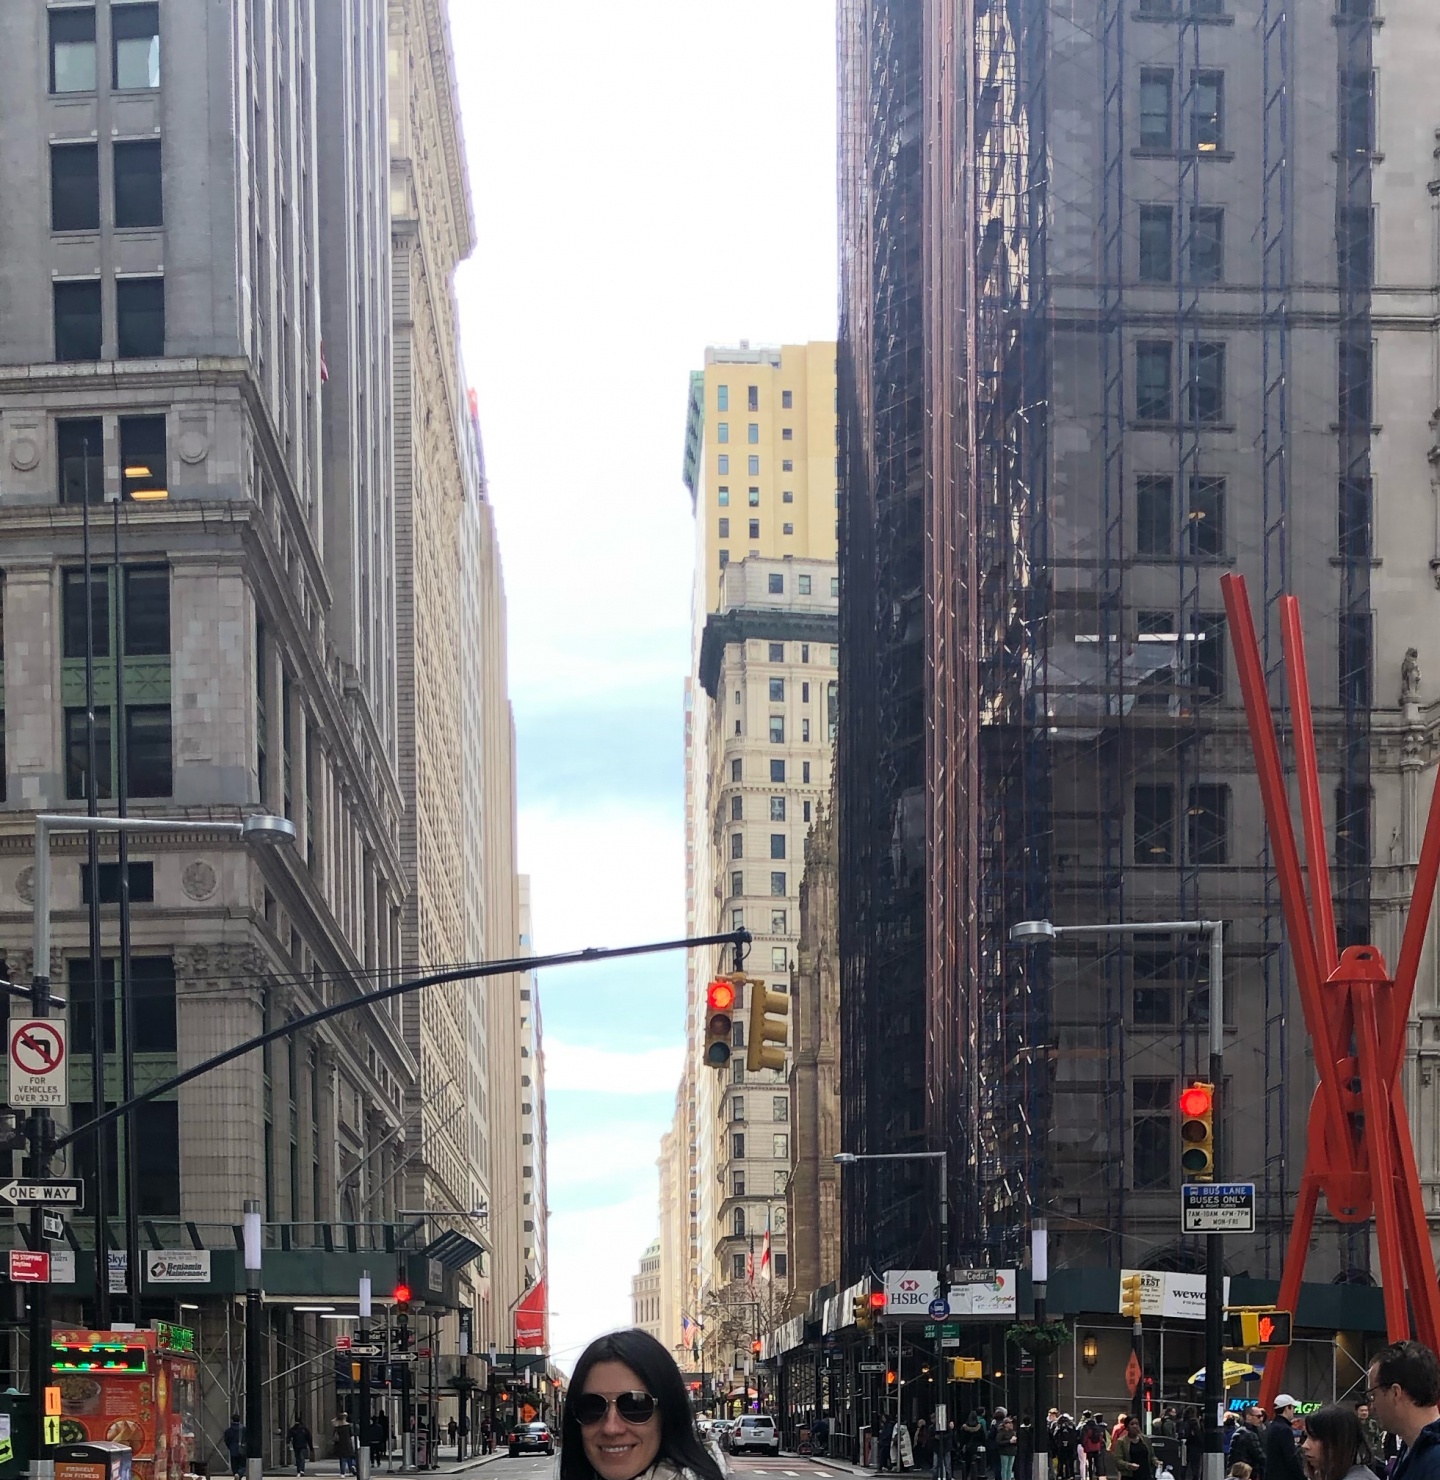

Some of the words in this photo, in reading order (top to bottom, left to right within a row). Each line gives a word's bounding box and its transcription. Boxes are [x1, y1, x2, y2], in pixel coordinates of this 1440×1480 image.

[30, 1077, 46, 1085] FOR
[18, 1086, 58, 1094] VEHICLES
[9, 1187, 36, 1199] ONE
[43, 1187, 70, 1199] WAY
[1203, 1187, 1220, 1195] BUS
[1223, 1187, 1246, 1195] LANE
[1190, 1196, 1220, 1204] BUSES
[1222, 1196, 1246, 1204] ONLY
[20, 1254, 43, 1262] STOPPING
[167, 1263, 202, 1271] Benjamin
[967, 1272, 988, 1280] Cedar
[891, 1293, 929, 1305] HSBC
